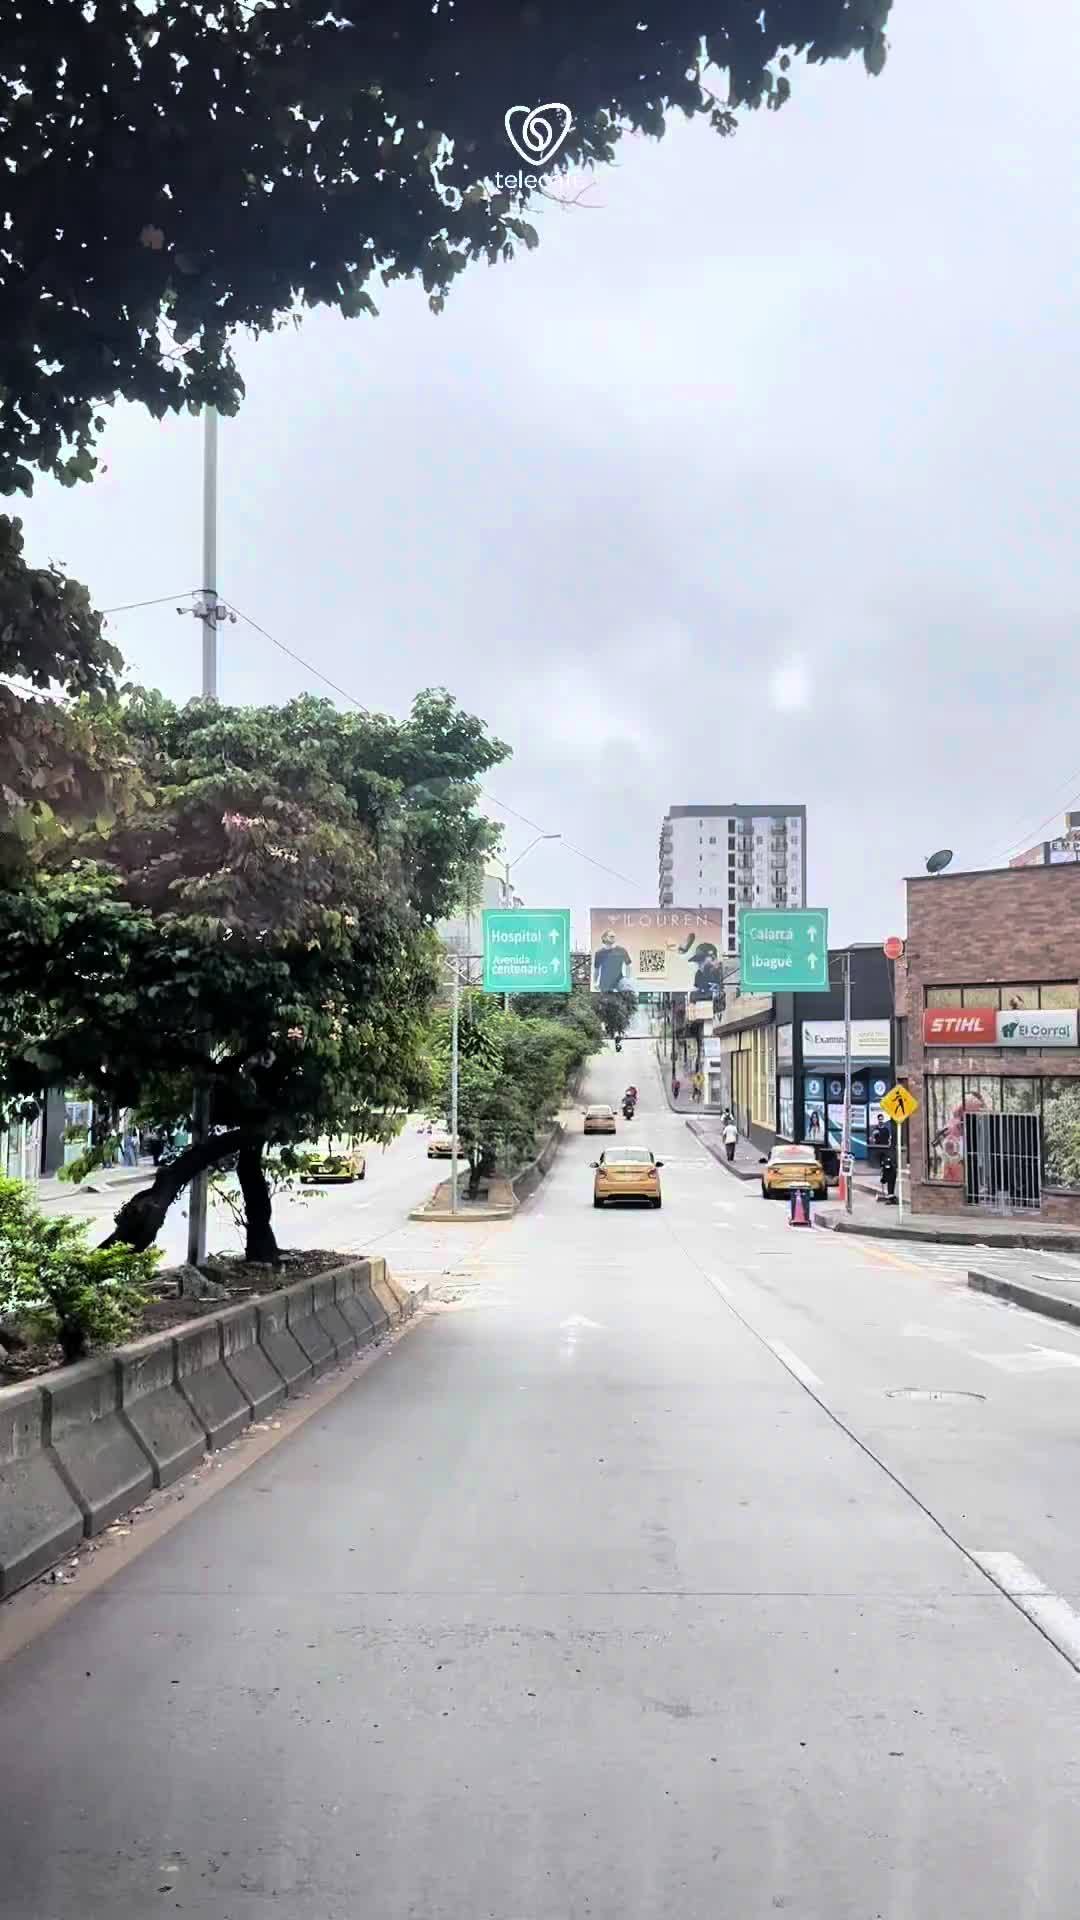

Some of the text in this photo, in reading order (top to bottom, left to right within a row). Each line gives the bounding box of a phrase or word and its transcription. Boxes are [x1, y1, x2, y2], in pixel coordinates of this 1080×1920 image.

[491, 929, 541, 944] Hospital
[492, 954, 530, 965] Avenida
[751, 954, 793, 969] Ibagué
[931, 1017, 985, 1033] STIHL
[1019, 1025, 1070, 1038] El Corral
